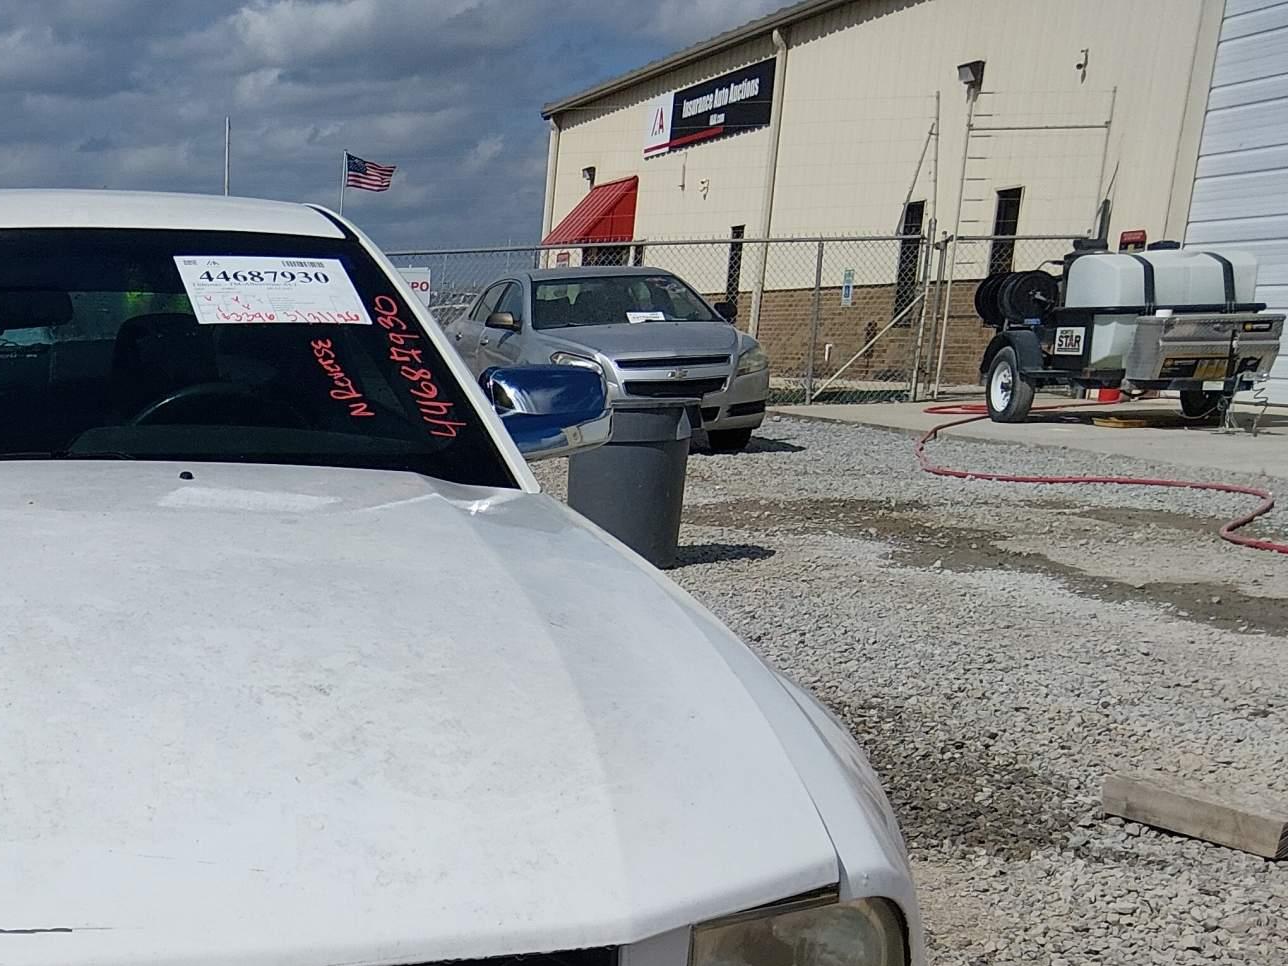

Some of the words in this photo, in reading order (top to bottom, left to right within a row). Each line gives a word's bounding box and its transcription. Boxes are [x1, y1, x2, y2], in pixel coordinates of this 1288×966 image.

[682, 93, 713, 118] Insurance
[713, 87, 729, 108] Auto
[728, 78, 760, 103] Auctions
[199, 270, 330, 284] 44687930
[409, 281, 429, 292] PO
[1057, 335, 1082, 348] STAR
[374, 295, 467, 437] 44687930
